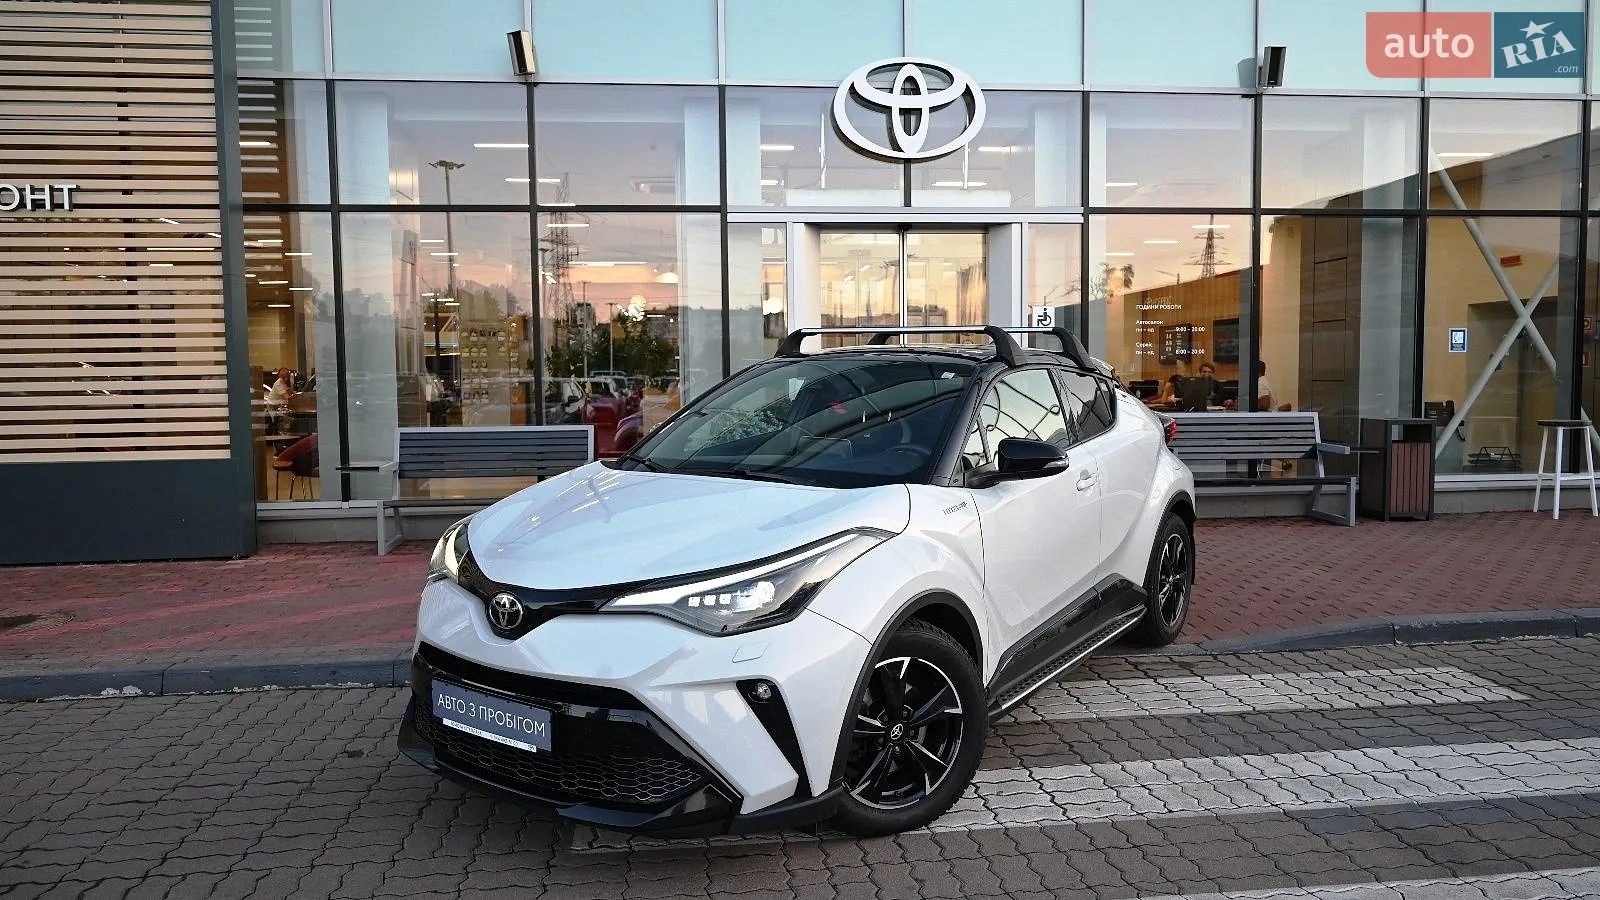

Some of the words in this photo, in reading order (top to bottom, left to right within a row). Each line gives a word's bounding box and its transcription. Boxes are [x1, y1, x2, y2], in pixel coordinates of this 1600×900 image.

[0, 184, 77, 211] ОНТ
[437, 693, 466, 714] АВТО
[479, 705, 545, 738] ПРОБІГОМ
